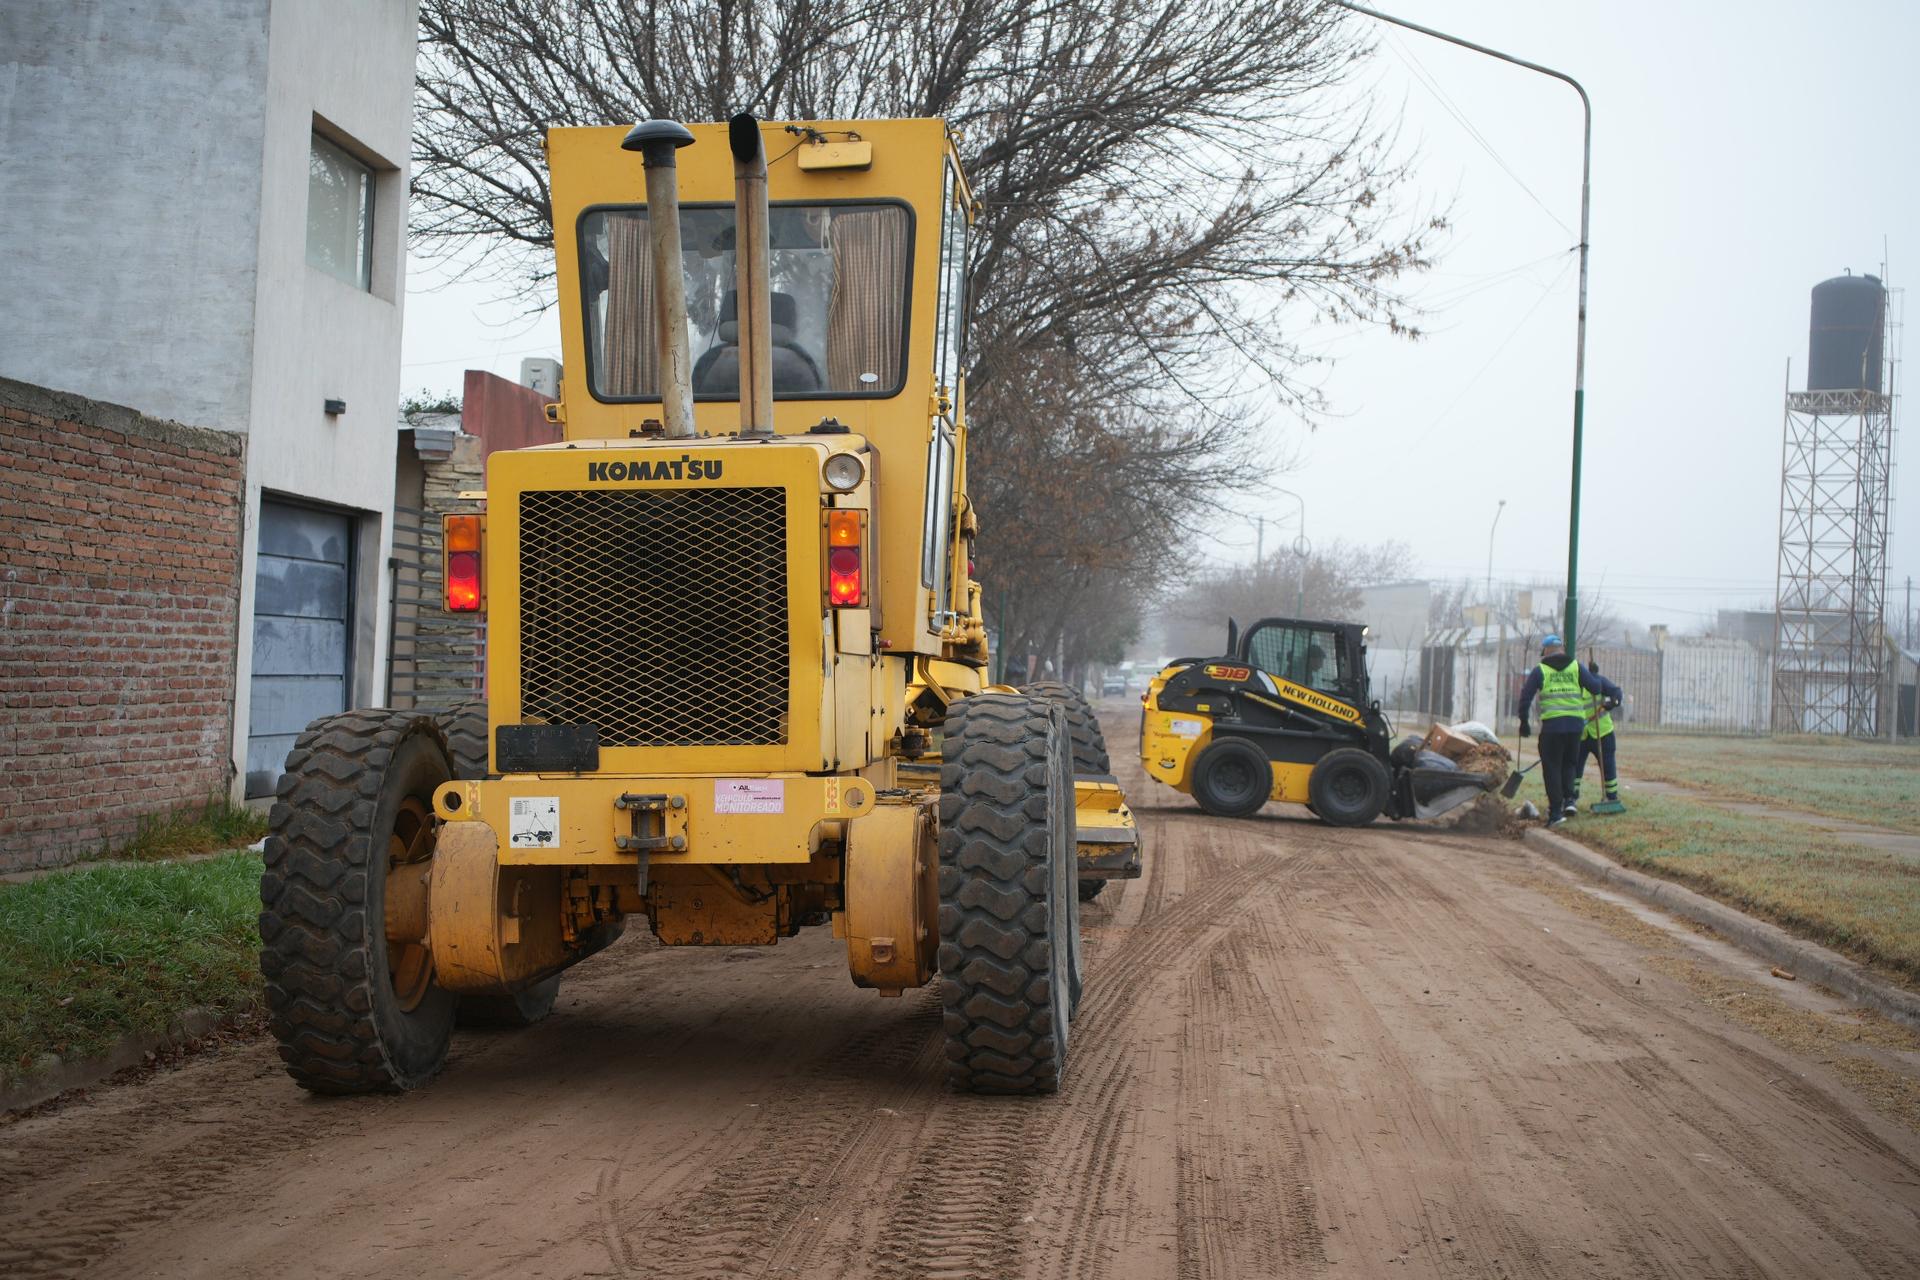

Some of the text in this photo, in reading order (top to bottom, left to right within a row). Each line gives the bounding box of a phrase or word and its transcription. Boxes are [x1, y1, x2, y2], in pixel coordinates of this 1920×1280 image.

[588, 455, 723, 482] KOMATSU
[1204, 665, 1251, 682] L318
[1282, 685, 1355, 719] NEW HOLLAND
[715, 801, 782, 812] MONITOREADO
